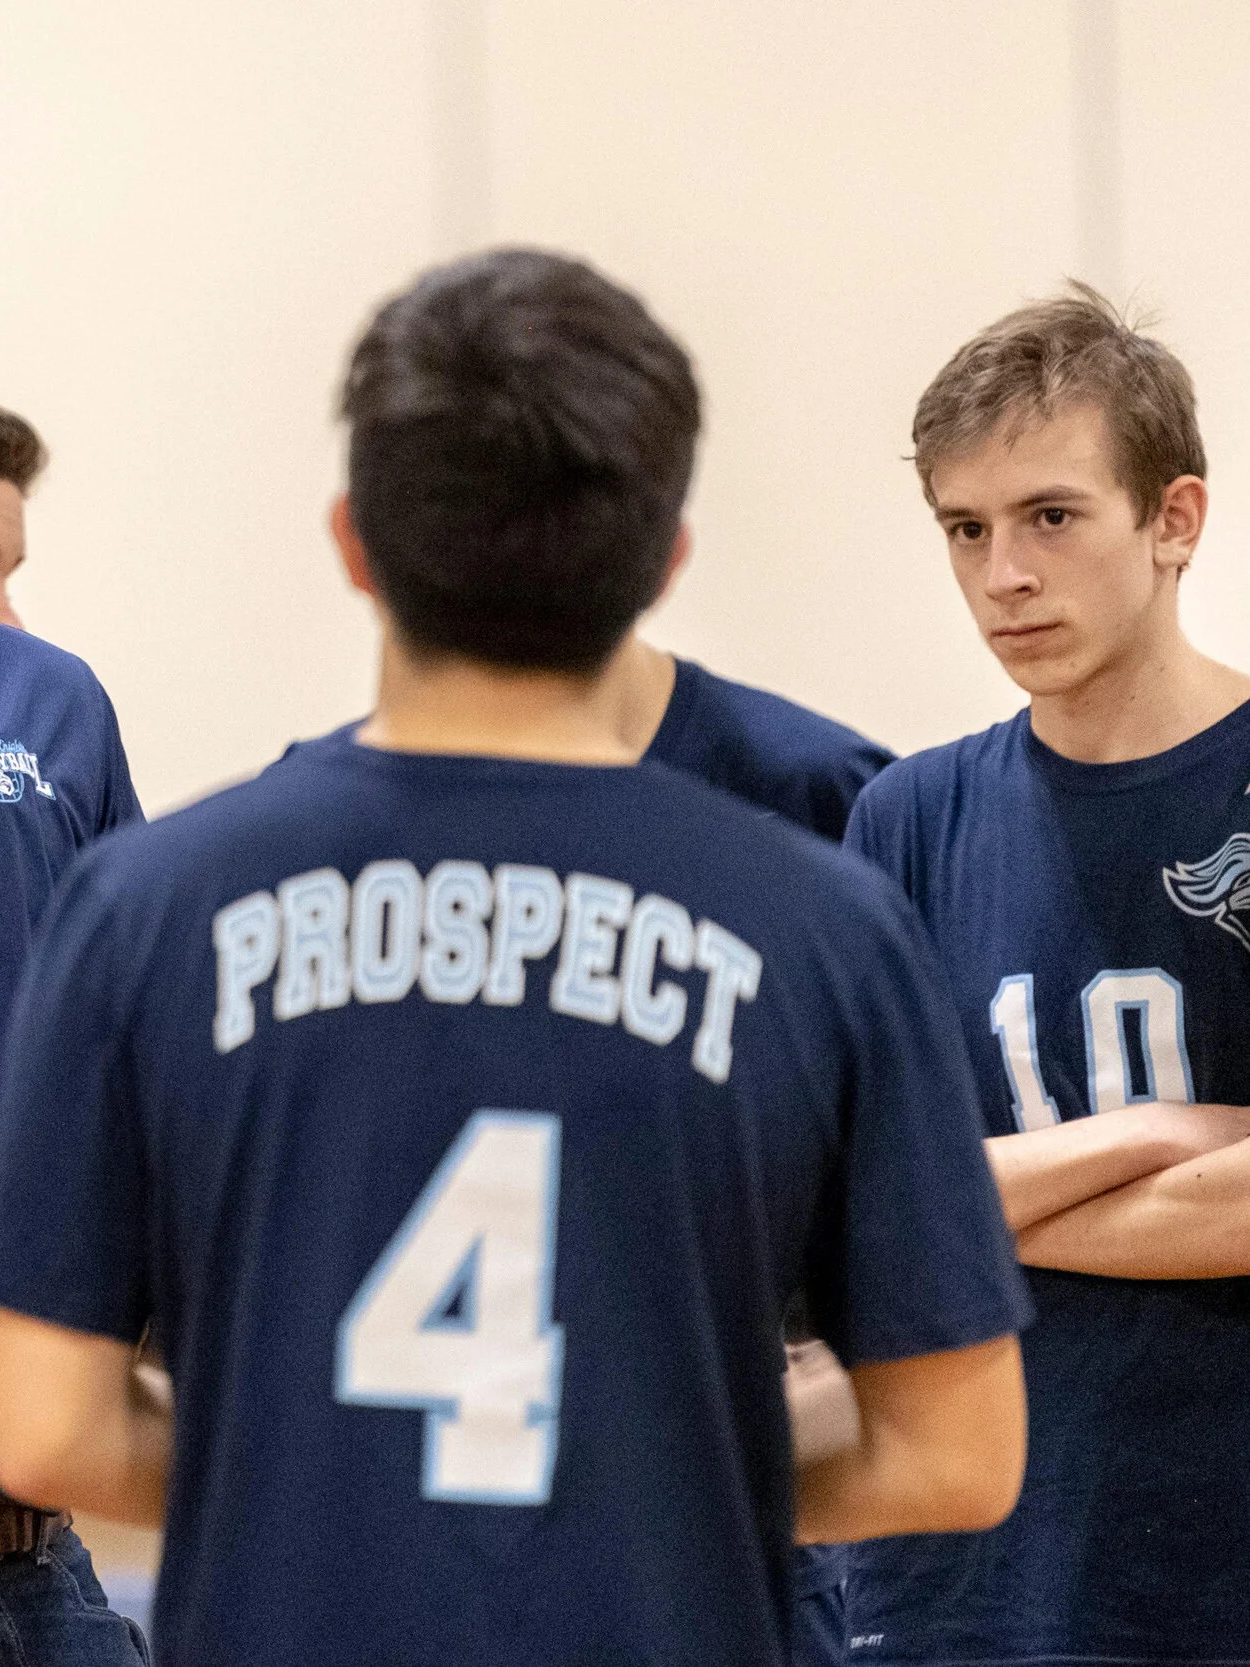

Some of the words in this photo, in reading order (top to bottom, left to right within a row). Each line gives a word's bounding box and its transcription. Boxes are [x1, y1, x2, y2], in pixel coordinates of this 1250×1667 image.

[213, 859, 762, 1084] PROSPECT
[990, 967, 1196, 1133] 10
[335, 1108, 565, 1506] 4
